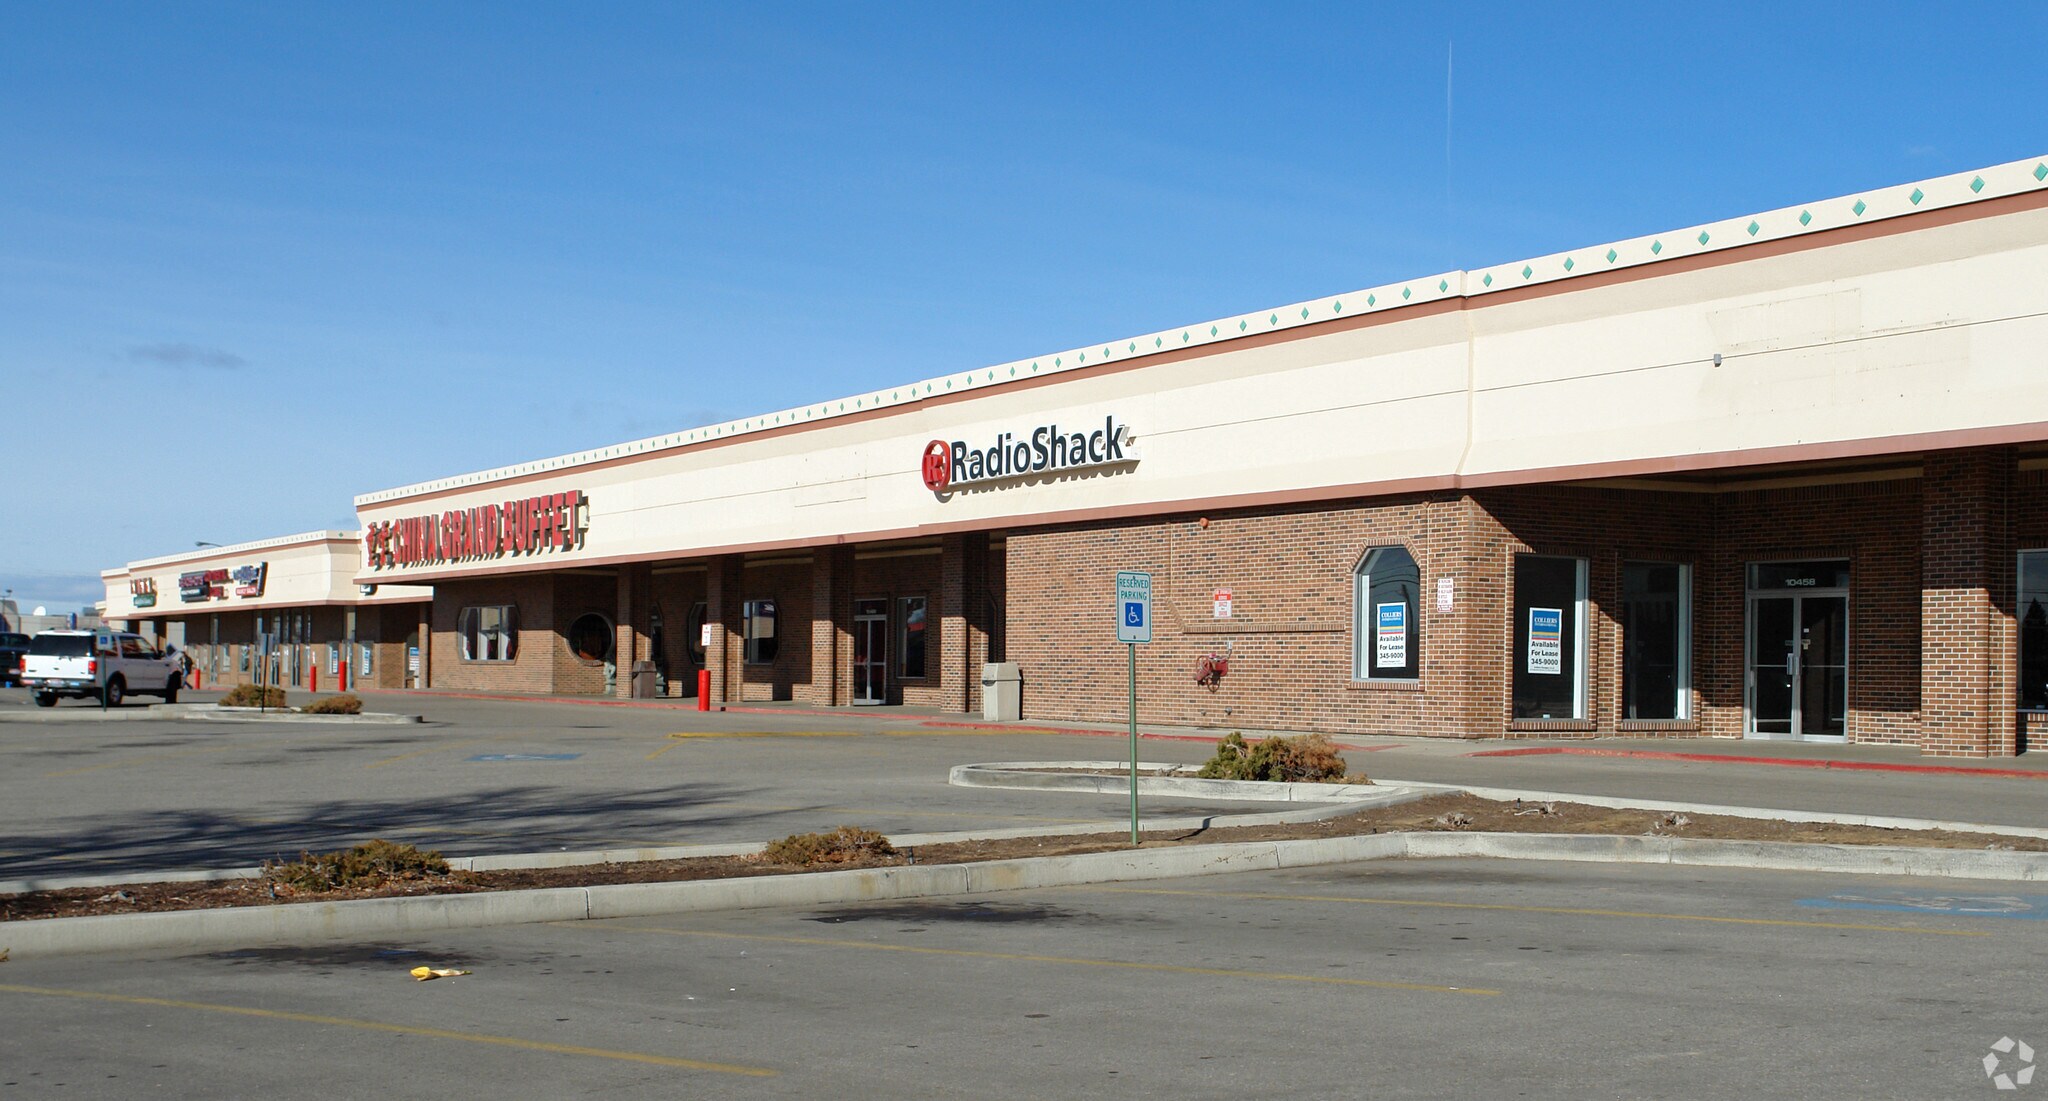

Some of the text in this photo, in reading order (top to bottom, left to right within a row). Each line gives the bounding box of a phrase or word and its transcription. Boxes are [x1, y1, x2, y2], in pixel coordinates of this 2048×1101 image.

[950, 415, 1124, 483] RadioShack
[393, 514, 438, 565] CHINA
[440, 504, 500, 560] GRAND
[503, 489, 583, 551] BUFFET
[1119, 578, 1148, 588] RESERVED
[1120, 590, 1147, 600] PARKING
[1531, 658, 1559, 666] 345-9000
